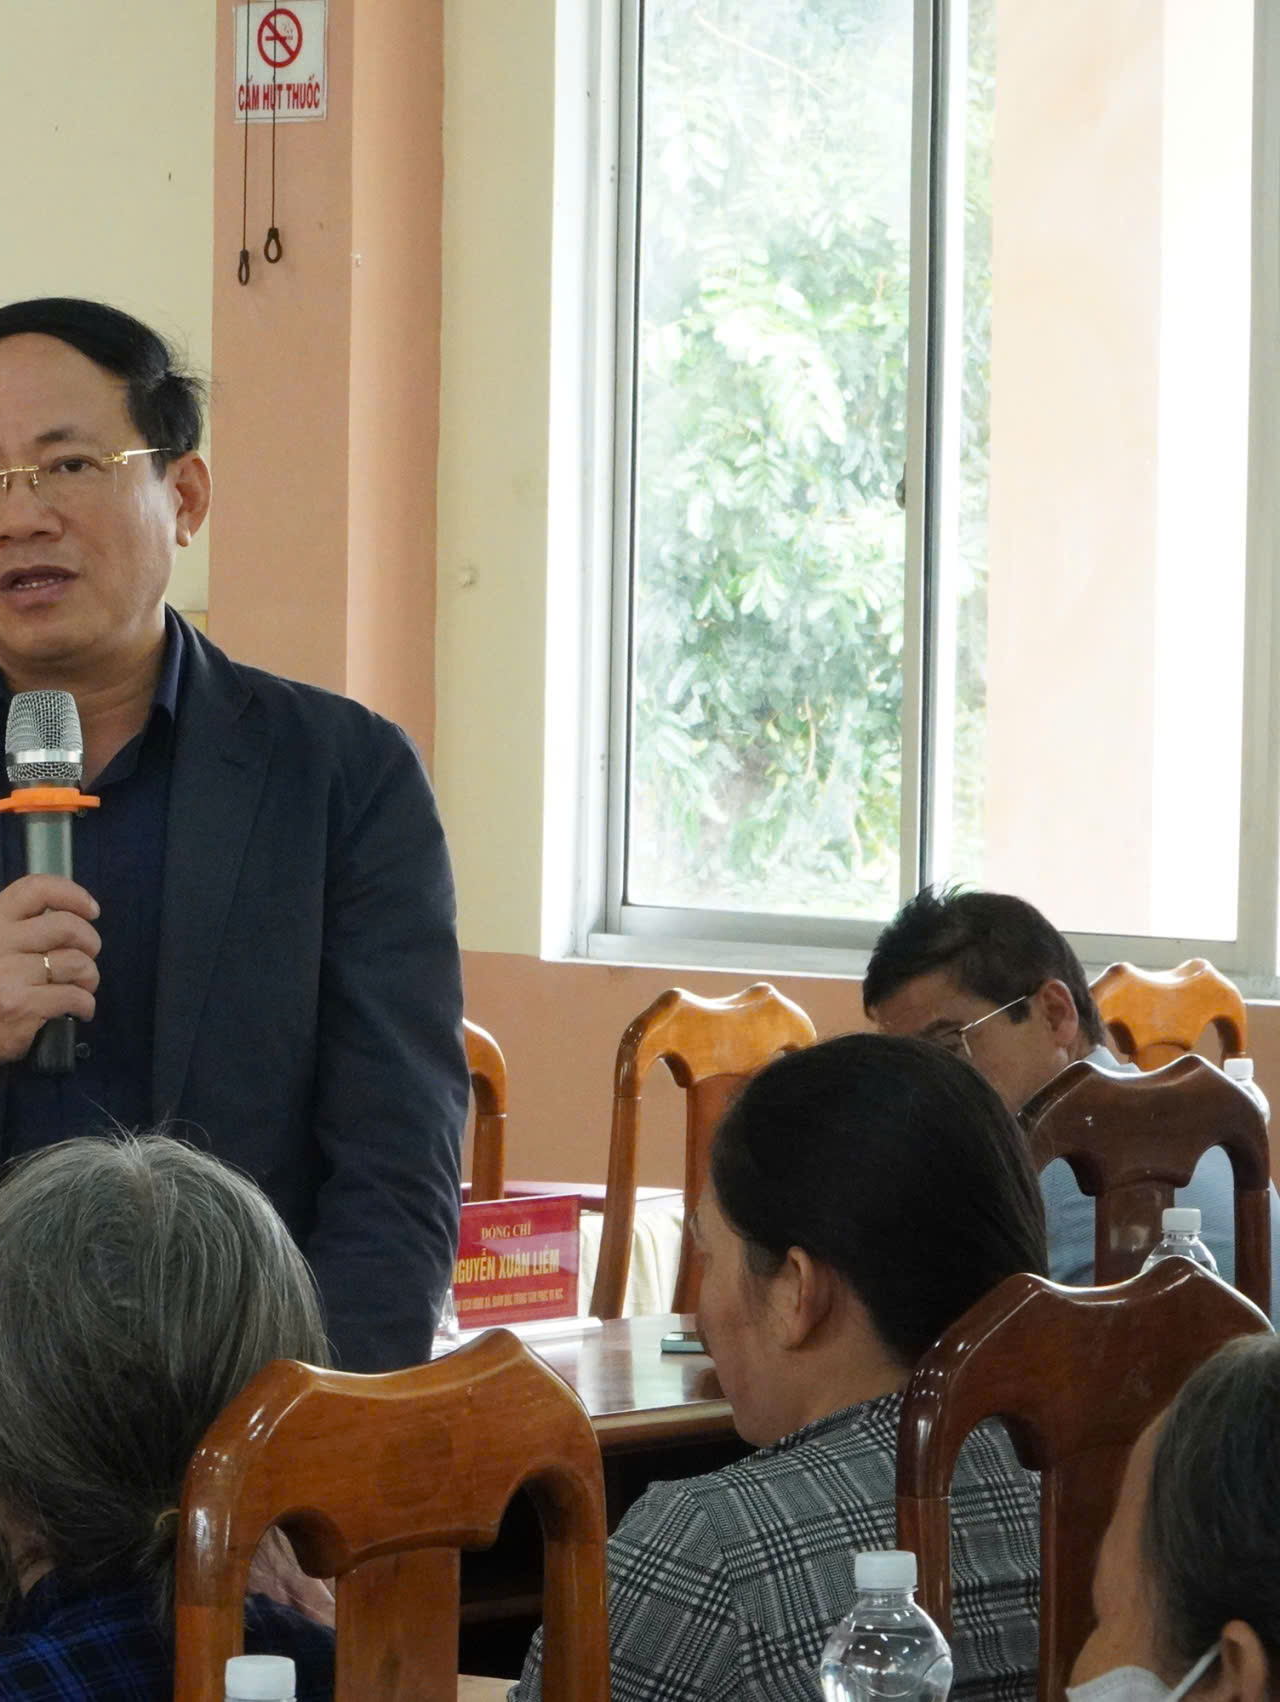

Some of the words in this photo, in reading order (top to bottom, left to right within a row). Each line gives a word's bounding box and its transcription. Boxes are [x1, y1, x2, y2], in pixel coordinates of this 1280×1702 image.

[238, 75, 260, 111] CẤM
[286, 73, 320, 110] THUỐC
[498, 1248, 530, 1280] XUÂN
